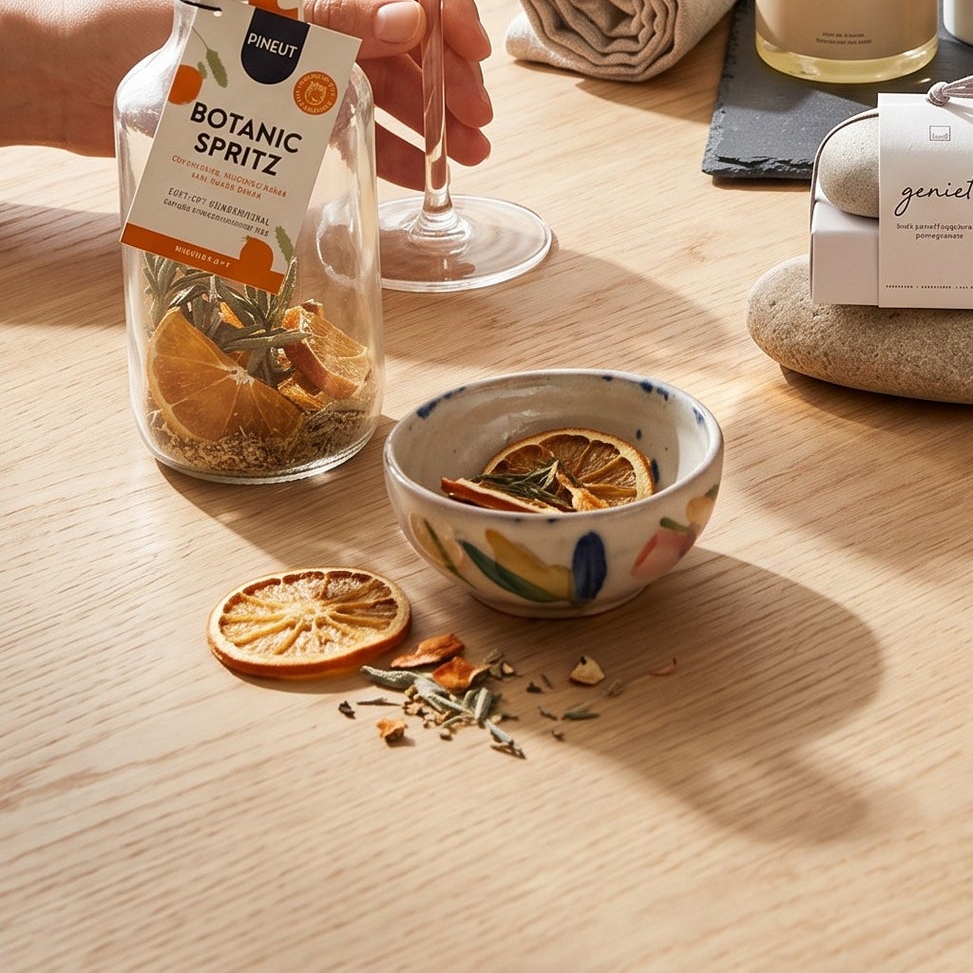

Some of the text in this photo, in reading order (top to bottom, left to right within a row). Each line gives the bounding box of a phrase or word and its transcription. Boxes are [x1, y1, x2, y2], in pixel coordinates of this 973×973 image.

[247, 32, 298, 58] PINEUT
[190, 102, 303, 154] BOTANIC
[194, 132, 282, 176] SPRITZ
